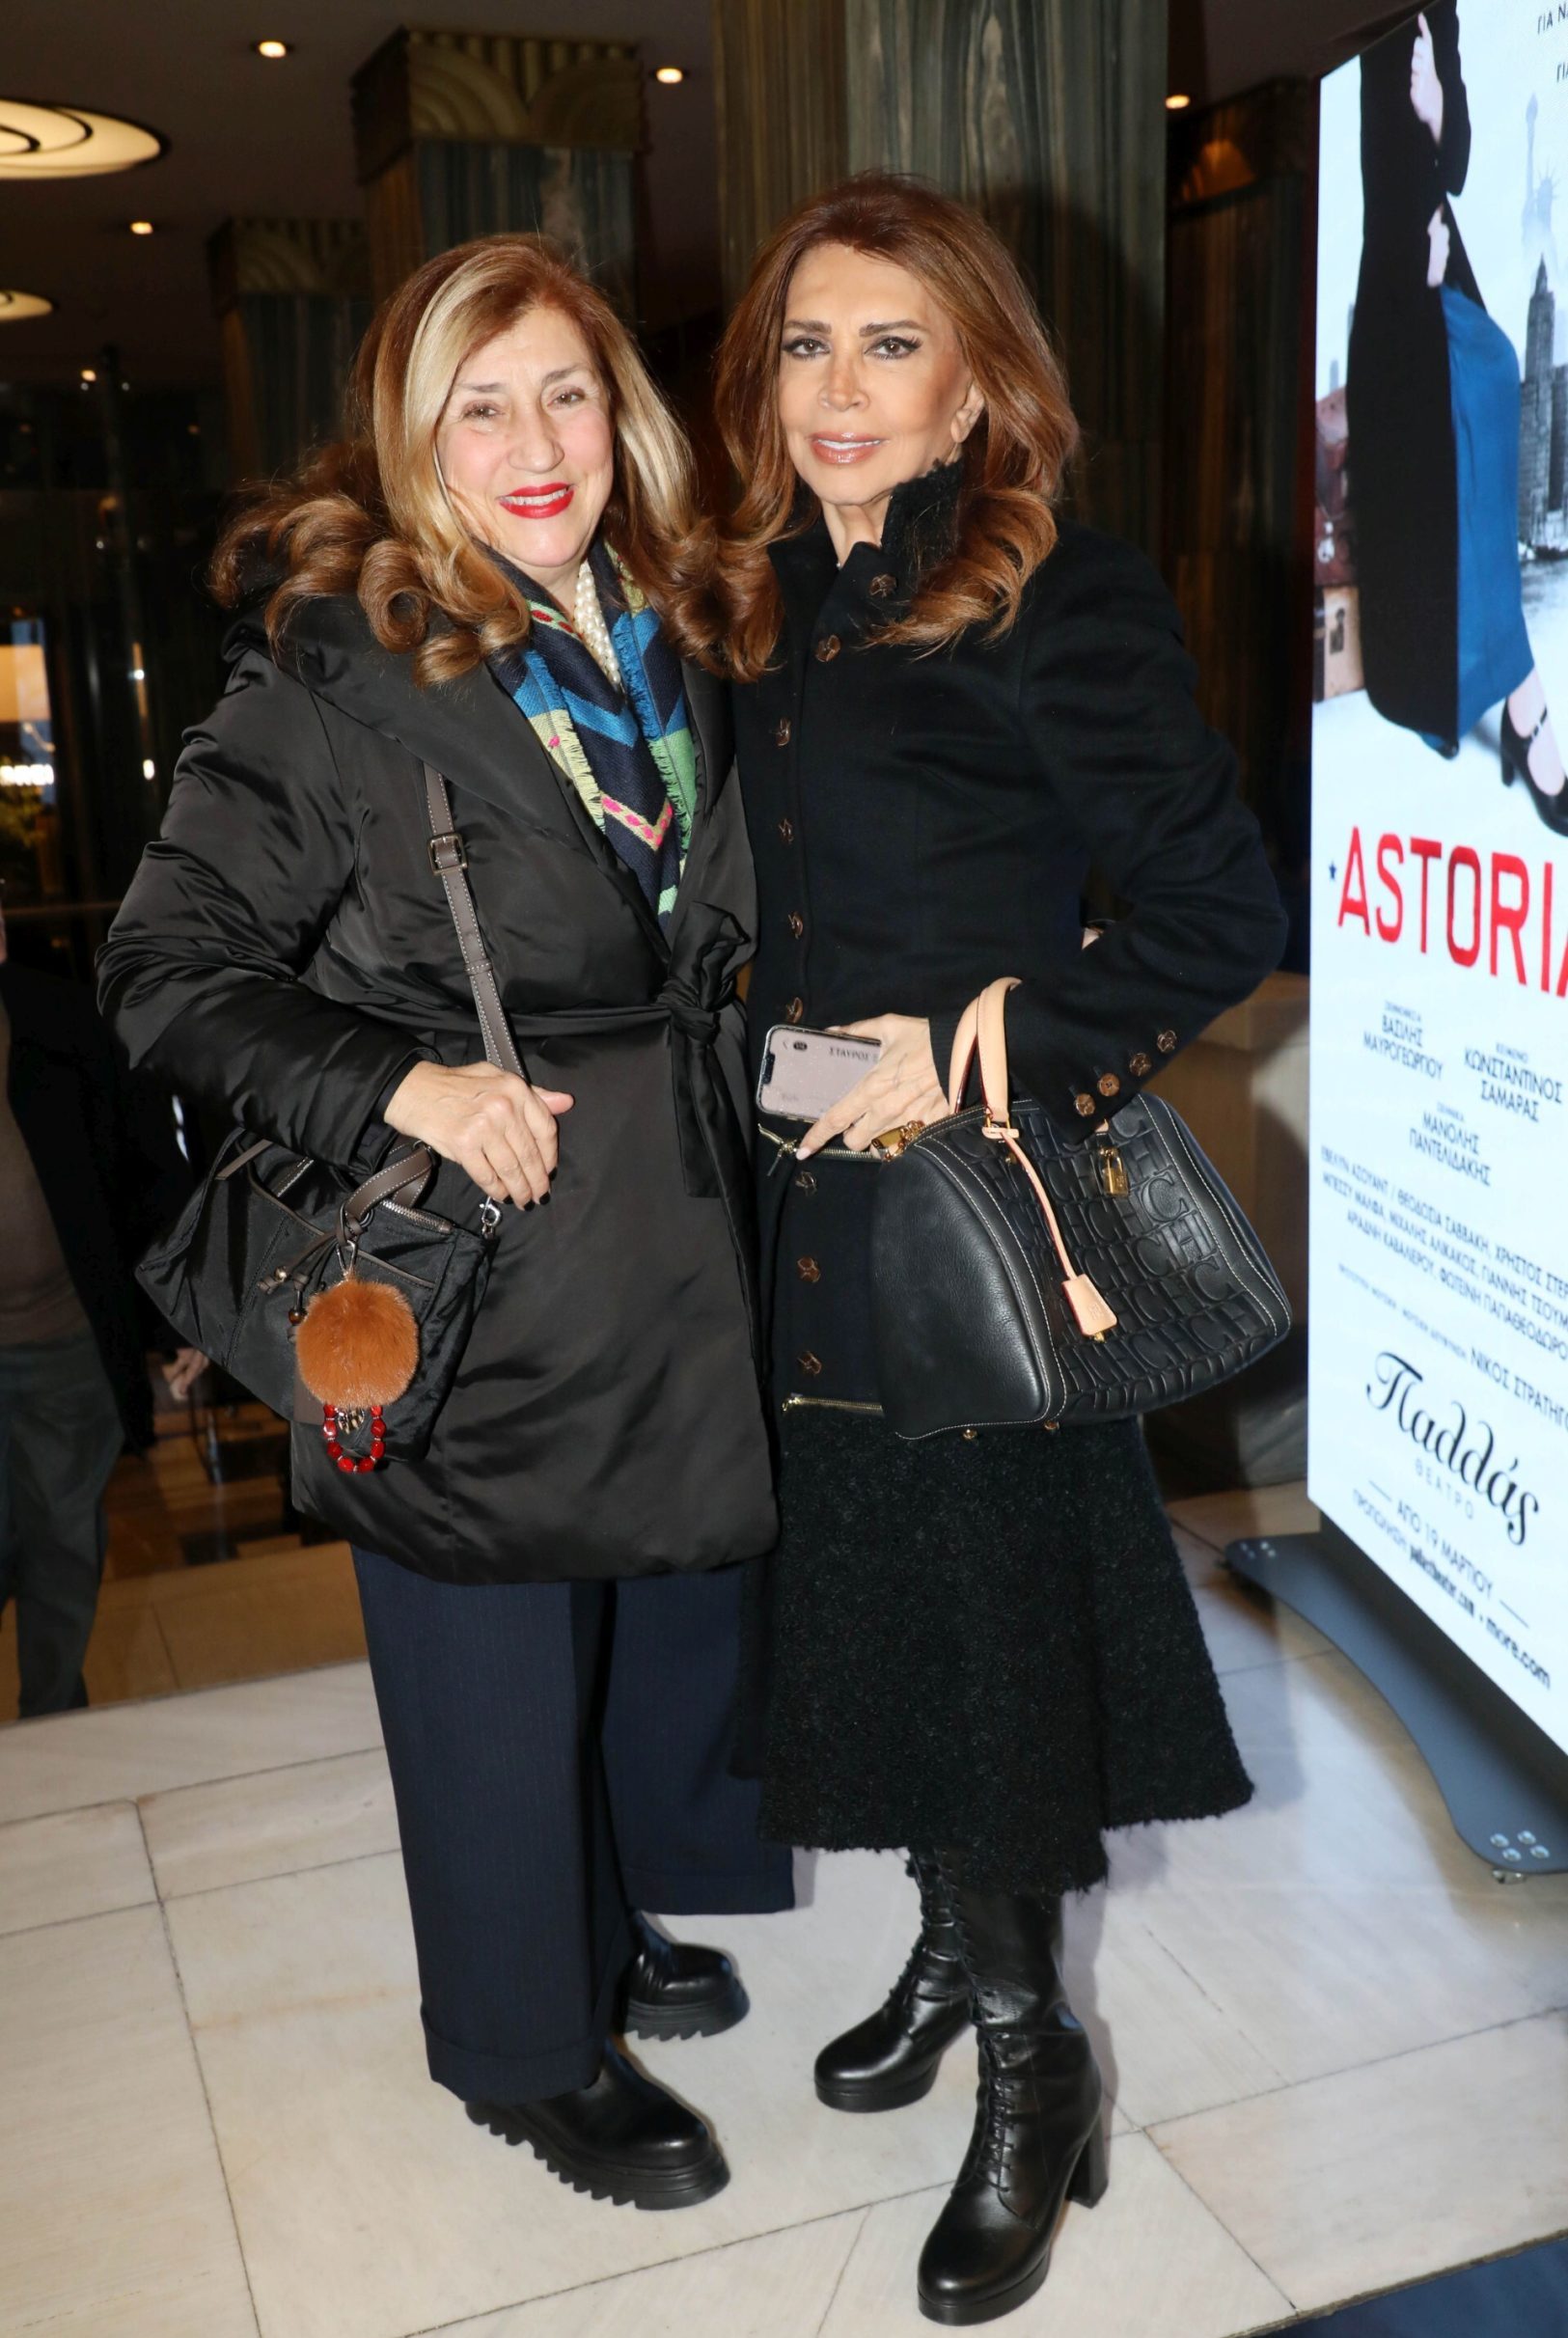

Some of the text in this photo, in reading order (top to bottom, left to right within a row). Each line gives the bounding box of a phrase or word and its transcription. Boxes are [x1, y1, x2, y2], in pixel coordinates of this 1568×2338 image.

[1537, 2, 1568, 35] ΓΙΑ Ν
[1382, 1014, 1423, 1048] ΒΑΣΙΛΗΣ
[1363, 1031, 1444, 1081] ΜΑΥΡΟΓΕΩΡΓΙΟΥ
[1464, 1047, 1562, 1104] ΚΩΝΣΤΑΝΤΙΝΟΣ
[1481, 1079, 1539, 1123] ΣΑΜΑΡΑΣ
[1422, 1111, 1479, 1155] ΜΑΝΟΛΗΣ
[1409, 1127, 1491, 1187] ΠΑΝΤΕΛΙΔΑΚΗΣ
[1482, 1265, 1527, 1307] ΓΙΑΝΝΗΣ
[1496, 1245, 1542, 1286] ΧΡΗΣΤΟΣ
[1471, 1347, 1509, 1390] ΝΙΚΟΣ
[1366, 1351, 1539, 1546] Παλλάς
[1415, 1458, 1474, 1521] ΘΕΑΤΡΟ
[1397, 1499, 1493, 1599] ΑΠΟ 19 ΜΑΡΤΙΟΥ
[1486, 1617, 1551, 1690] more.com
